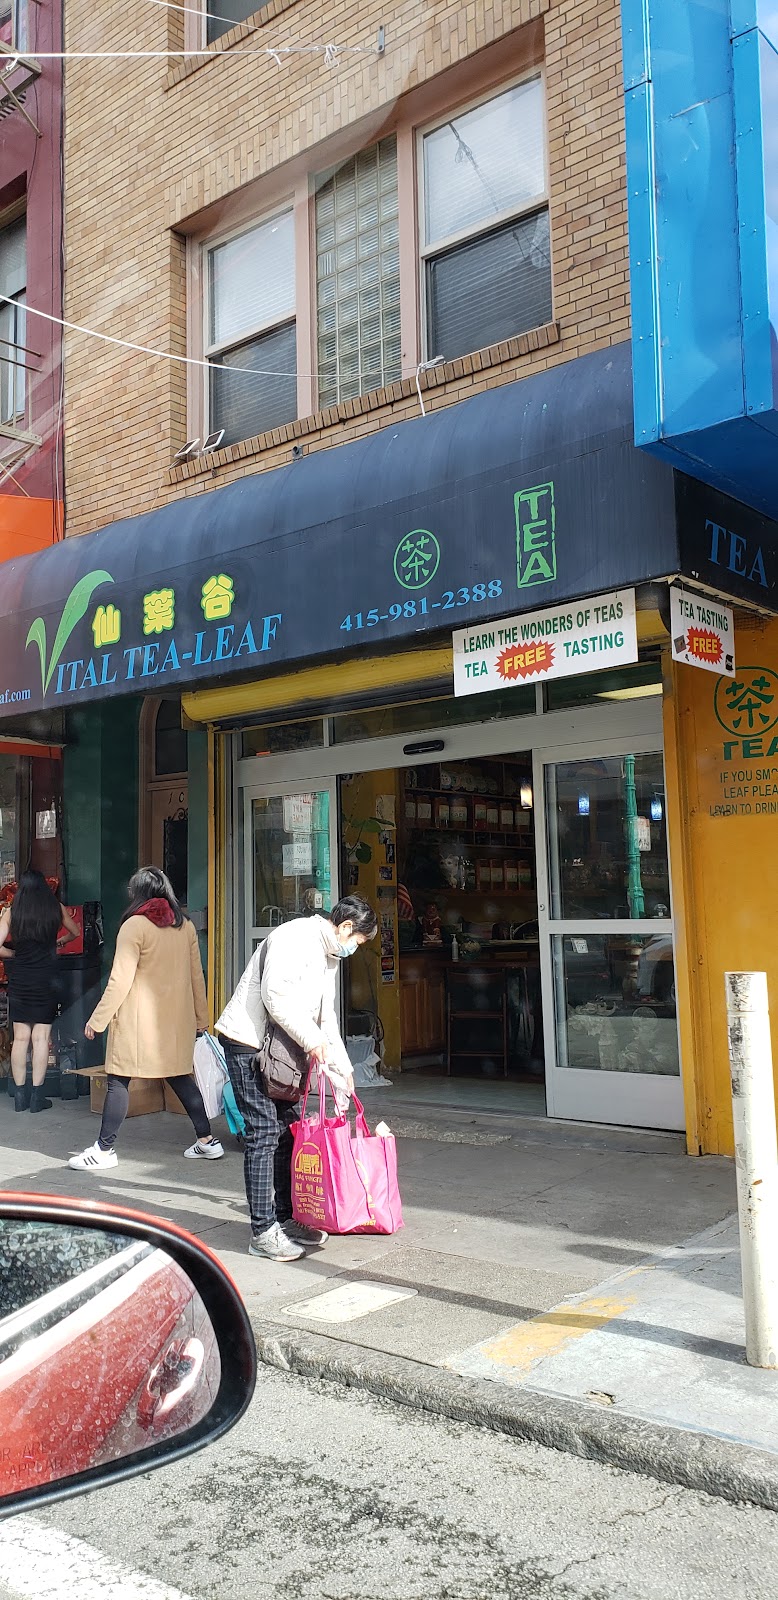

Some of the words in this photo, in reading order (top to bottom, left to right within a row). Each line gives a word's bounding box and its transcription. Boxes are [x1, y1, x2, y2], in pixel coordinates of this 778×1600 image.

[401, 535, 433, 582] 茶
[519, 489, 554, 584] TEA
[705, 519, 769, 588] TEA
[92, 573, 235, 648] 仙葉谷
[339, 579, 503, 632] 415-981-2388
[463, 632, 495, 654] LEARN
[498, 627, 518, 646] THE
[521, 613, 573, 641] WONDERS
[576, 609, 591, 629] OF
[594, 602, 624, 624] TEAS
[678, 598, 695, 620] TEA
[697, 605, 729, 632] TASTING
[123, 613, 283, 681] TEA-LEAF
[465, 661, 488, 678] TEA
[503, 645, 547, 674] FREE
[563, 631, 625, 658] TASTING
[693, 637, 718, 654] FREE
[726, 675, 775, 729] 茶
[720, 771, 729, 783] IF
[731, 770, 753, 782] YOU
[724, 786, 749, 799] LEAF
[740, 803, 752, 814] TO
